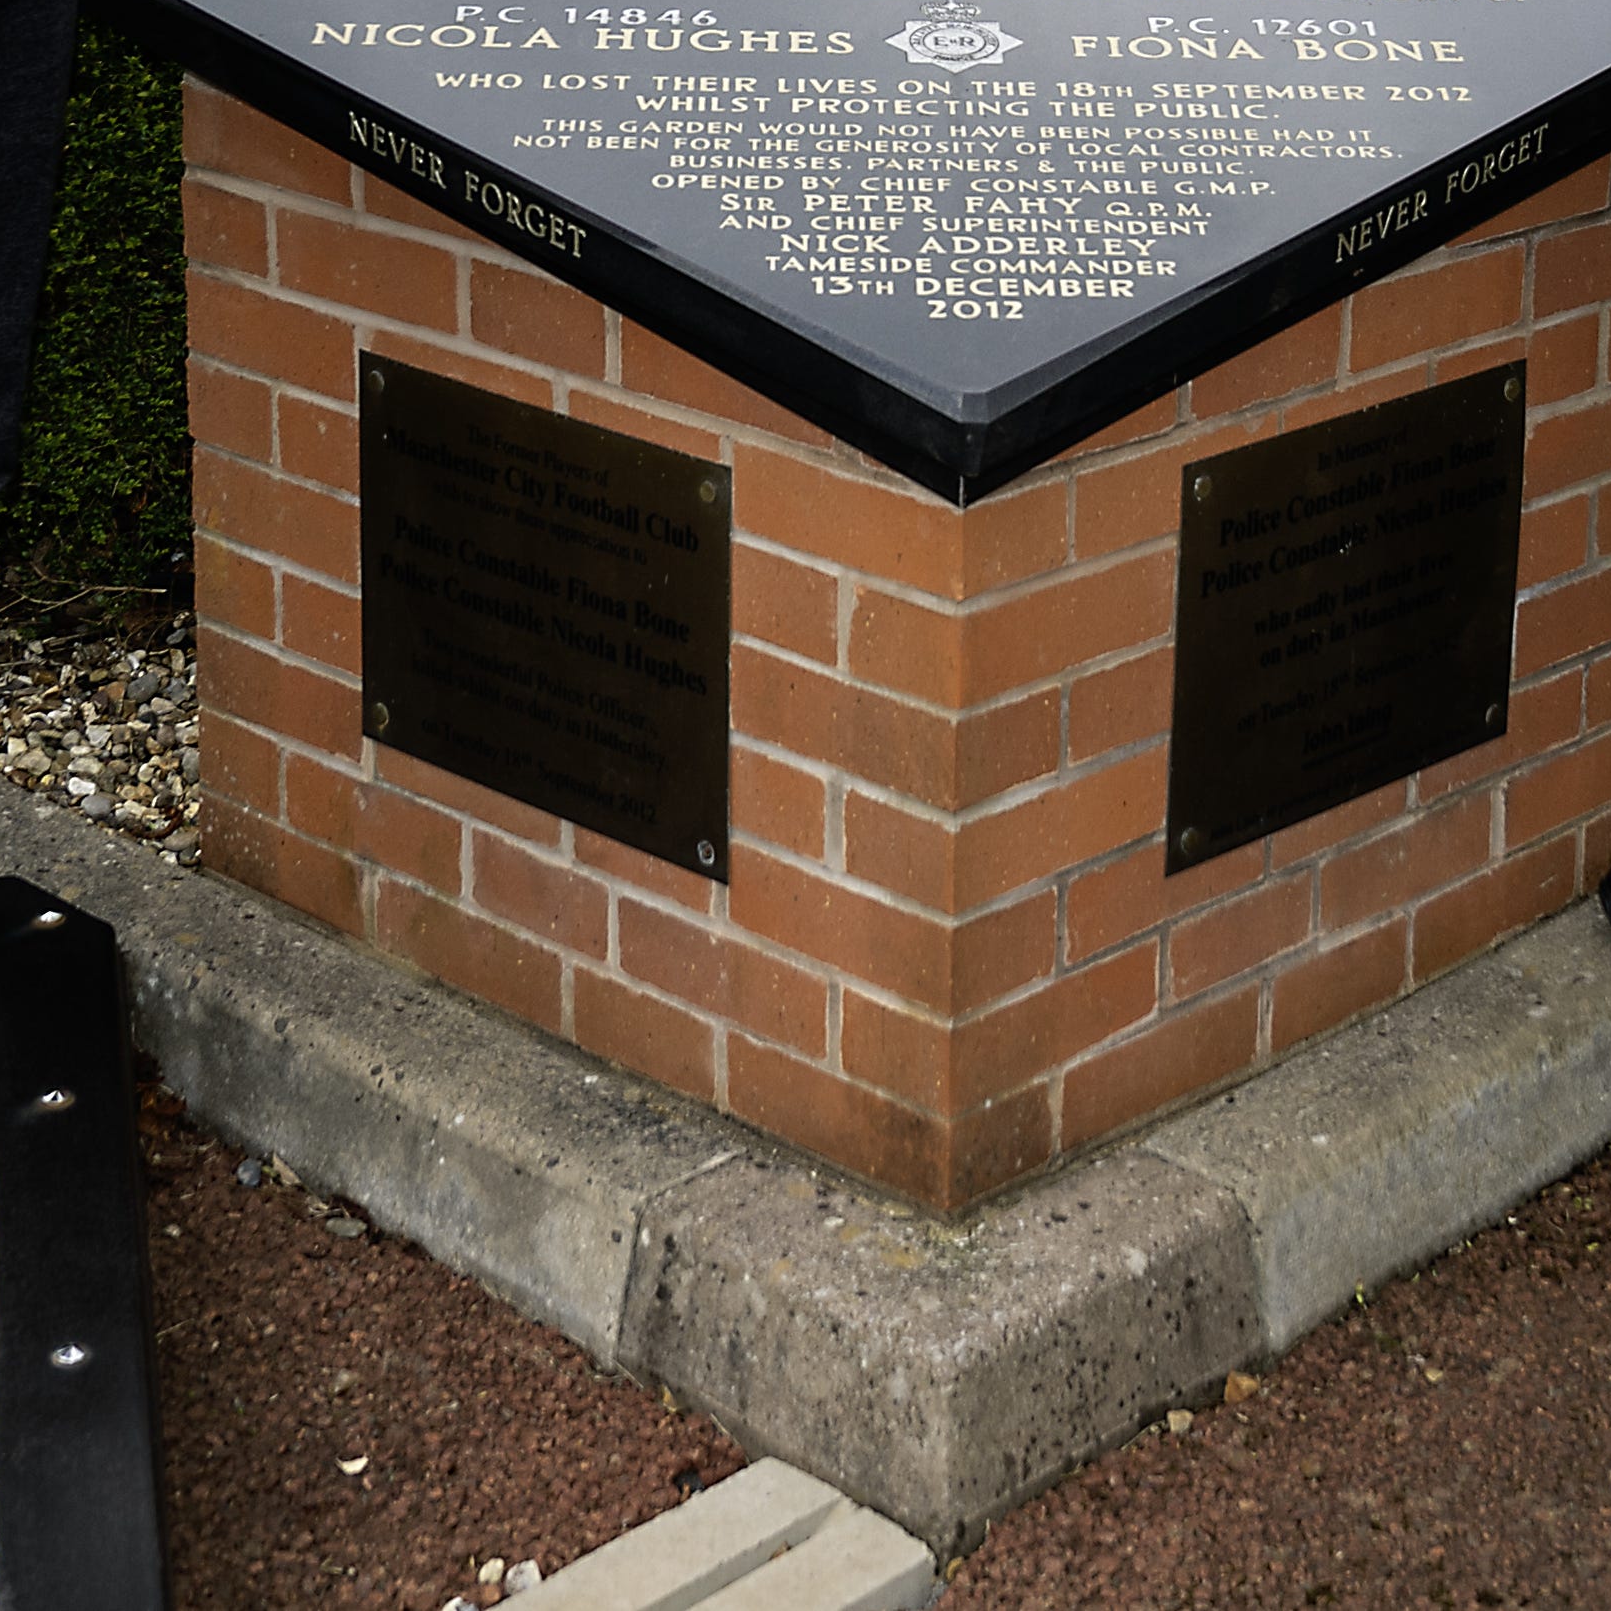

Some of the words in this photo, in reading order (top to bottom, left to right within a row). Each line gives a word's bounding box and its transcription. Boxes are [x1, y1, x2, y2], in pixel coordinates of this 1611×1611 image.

[455, 5, 538, 24] P.C.
[564, 7, 718, 26] 14846
[1147, 17, 1230, 35] P.C.
[1251, 18, 1377, 37] 12601
[310, 22, 562, 49] NICOLA
[593, 27, 855, 54] HUGHES
[1070, 35, 1265, 60] FIONA
[1292, 39, 1465, 62] BONE
[435, 72, 523, 89] WHO
[542, 73, 632, 91] LOST
[651, 75, 758, 93] THEIR
[777, 77, 878, 95] LIVES
[897, 79, 951, 96] ON
[970, 80, 1037, 97] THE
[1151, 83, 1366, 101] SEPTEMBER
[1384, 86, 1473, 102] 2012
[635, 94, 772, 113] WHILST
[791, 97, 1030, 117] PROTECTING
[1048, 101, 1116, 118] THE
[1134, 102, 1280, 120] PUBLIC.
[542, 118, 603, 133] THIS
[618, 120, 744, 135] GARDEN
[758, 122, 863, 136] WOULD
[878, 124, 934, 137] NOT
[949, 125, 1026, 139] HAVE
[1039, 126, 1111, 140] BEEN
[1124, 127, 1260, 141] POSSIBLE
[1272, 128, 1335, 142] HAD
[1348, 129, 1372, 142] IT
[513, 134, 572, 149] NOT
[586, 135, 660, 150] BEEN
[673, 137, 732, 151] FOR
[747, 138, 800, 152] THE
[815, 139, 1000, 155] GENEROSITY
[1015, 141, 1052, 155] OF
[1067, 142, 1164, 157] LOCAL
[1177, 143, 1403, 159] CONTRACTORS.
[867, 157, 1019, 173] PARTNERS
[1037, 159, 1056, 174] &
[1073, 159, 1127, 174] THE
[1140, 160, 1254, 175] PUBLIC.
[349, 111, 447, 189] NEVER
[464, 170, 587, 258] FORGET
[651, 173, 785, 190] OPENED
[801, 175, 842, 191] BY
[860, 176, 952, 193] CHIEF
[970, 178, 1158, 195] CONSTABLE
[1173, 180, 1276, 196] G.M.P.
[1335, 189, 1428, 263] NEVER
[1445, 123, 1549, 204] FORGET
[803, 193, 938, 214] PETER
[964, 195, 1083, 215] FAHY
[1105, 201, 1212, 218] Q.P.M.
[718, 214, 793, 231] AND
[810, 215, 904, 232] CHIEF
[922, 216, 1209, 236] SUPERINTENDENT
[780, 233, 892, 254] NICK
[917, 235, 1157, 257] ADDERLEY
[764, 255, 933, 274] TAMESIDE
[950, 258, 1177, 276] COMMANDER
[915, 277, 1135, 298] DECEMBER
[926, 299, 1025, 320] 2012
[385, 423, 498, 486] Manchester
[503, 462, 548, 507] City
[554, 479, 639, 534] Football
[645, 510, 699, 554] Club
[593, 469, 608, 488] of
[1219, 506, 1282, 549] Police
[1285, 469, 1386, 526] Constable
[1389, 453, 1444, 491] Fiona
[1449, 436, 1496, 471] Bone
[1200, 557, 1264, 600] Police
[1267, 520, 1369, 577] Constable
[1373, 497, 1434, 540] Nicola
[393, 513, 453, 559] Police
[457, 535, 561, 598] Constable
[566, 574, 627, 622] Fiona
[634, 598, 690, 644] Bone
[380, 550, 438, 597] Police
[442, 573, 546, 637] Constable
[550, 613, 618, 664] Nicola
[622, 639, 708, 697] Hughes
[1252, 608, 1292, 639] who
[1293, 589, 1340, 624] sadly
[1259, 644, 1282, 669] on
[537, 670, 585, 708] Police
[565, 712, 580, 737] in
